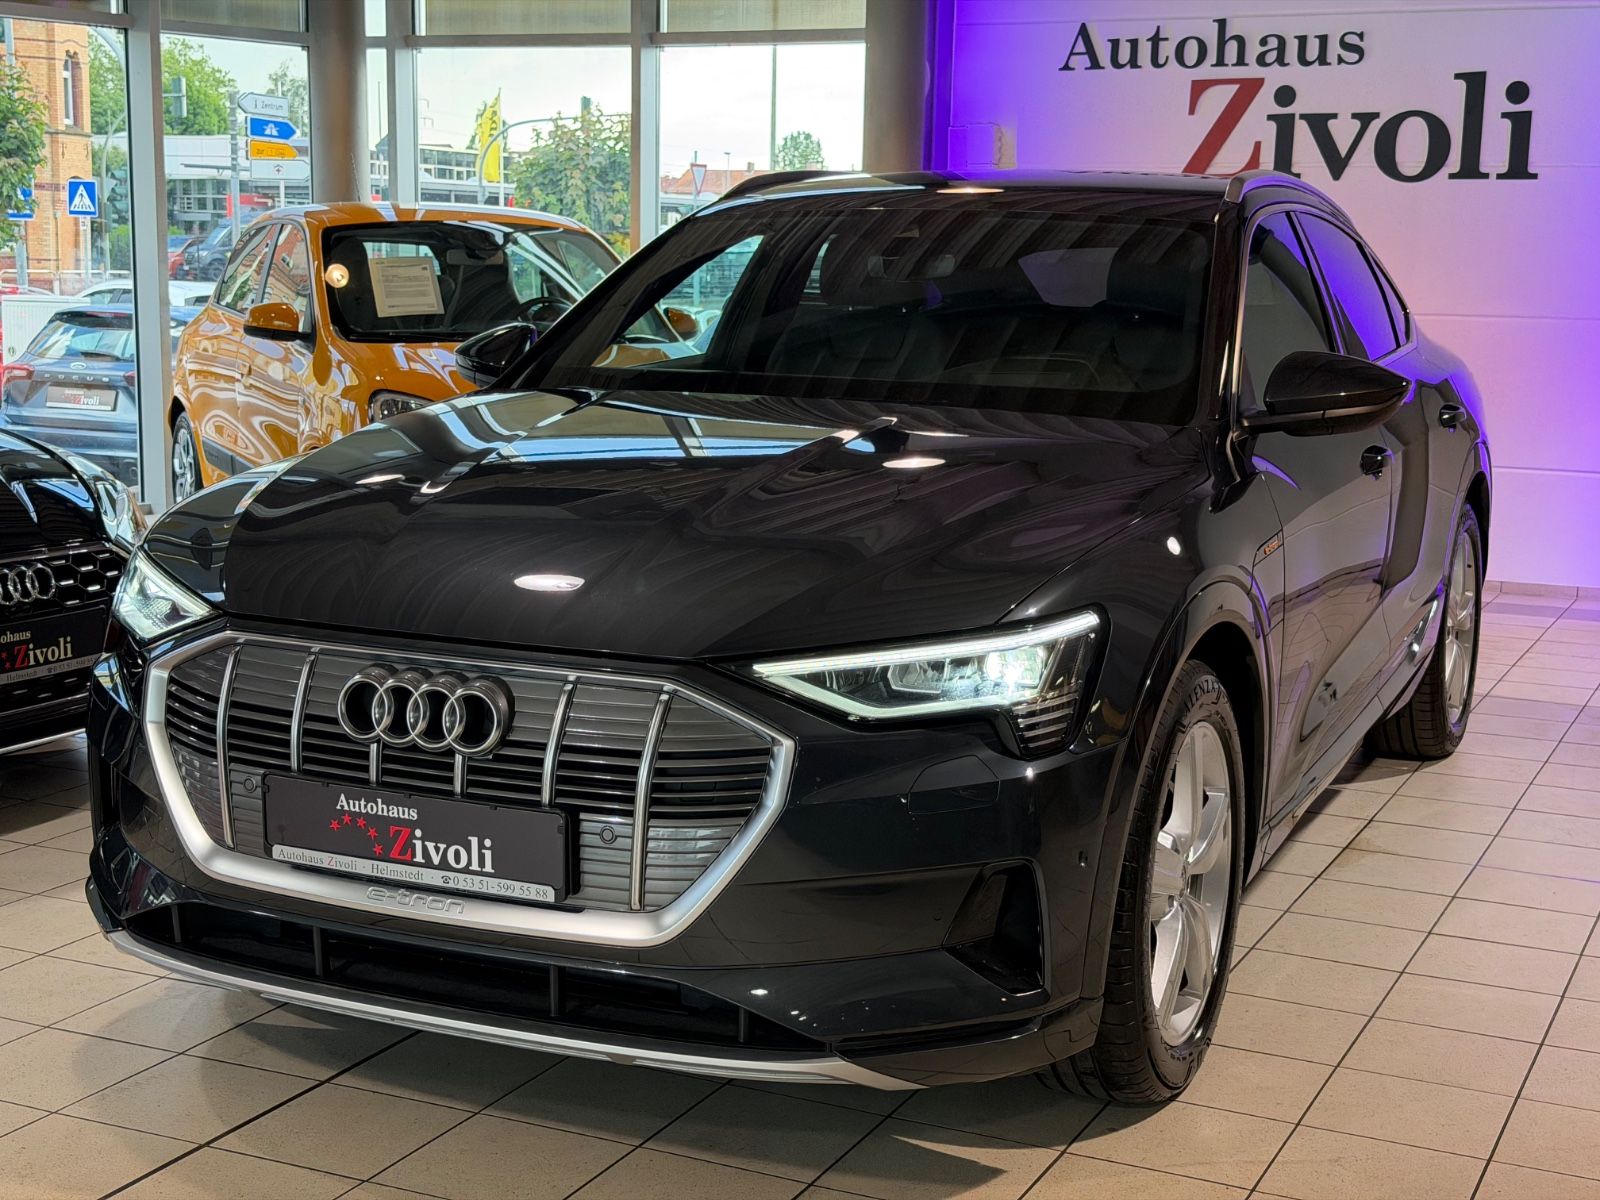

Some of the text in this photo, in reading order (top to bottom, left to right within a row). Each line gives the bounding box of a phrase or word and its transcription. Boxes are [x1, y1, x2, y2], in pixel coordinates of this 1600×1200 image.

[1058, 18, 1365, 71] Autohaus
[1181, 71, 1538, 183] Zivoli
[0, 630, 31, 644] ohaus
[14, 636, 73, 669] Zivoli
[335, 793, 418, 821] Autohaus
[389, 825, 495, 873] Zivoli
[278, 848, 324, 865] Autohaus
[327, 856, 358, 871] Zivoli
[371, 863, 424, 881] Helmstedt
[462, 877, 475, 889] 53
[478, 880, 516, 894] 51-599
[519, 886, 532, 897] 55
[535, 887, 548, 900] 88
[367, 886, 465, 914] e-tron
